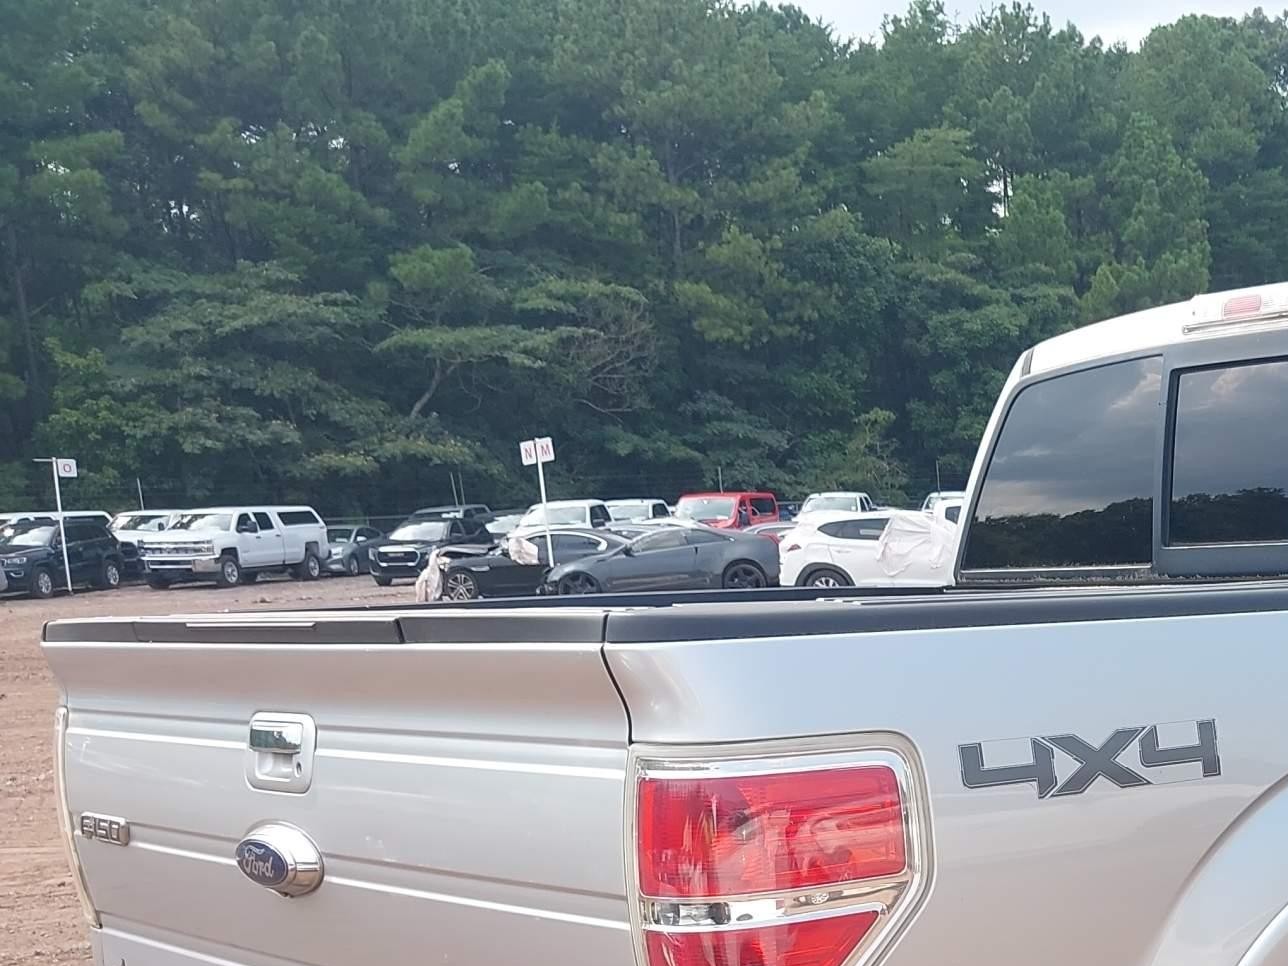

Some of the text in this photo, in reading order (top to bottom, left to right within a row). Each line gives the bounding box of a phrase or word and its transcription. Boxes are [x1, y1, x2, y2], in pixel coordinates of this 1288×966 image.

[524, 447, 533, 460] N
[540, 444, 551, 457] M
[243, 845, 275, 878] Ford
